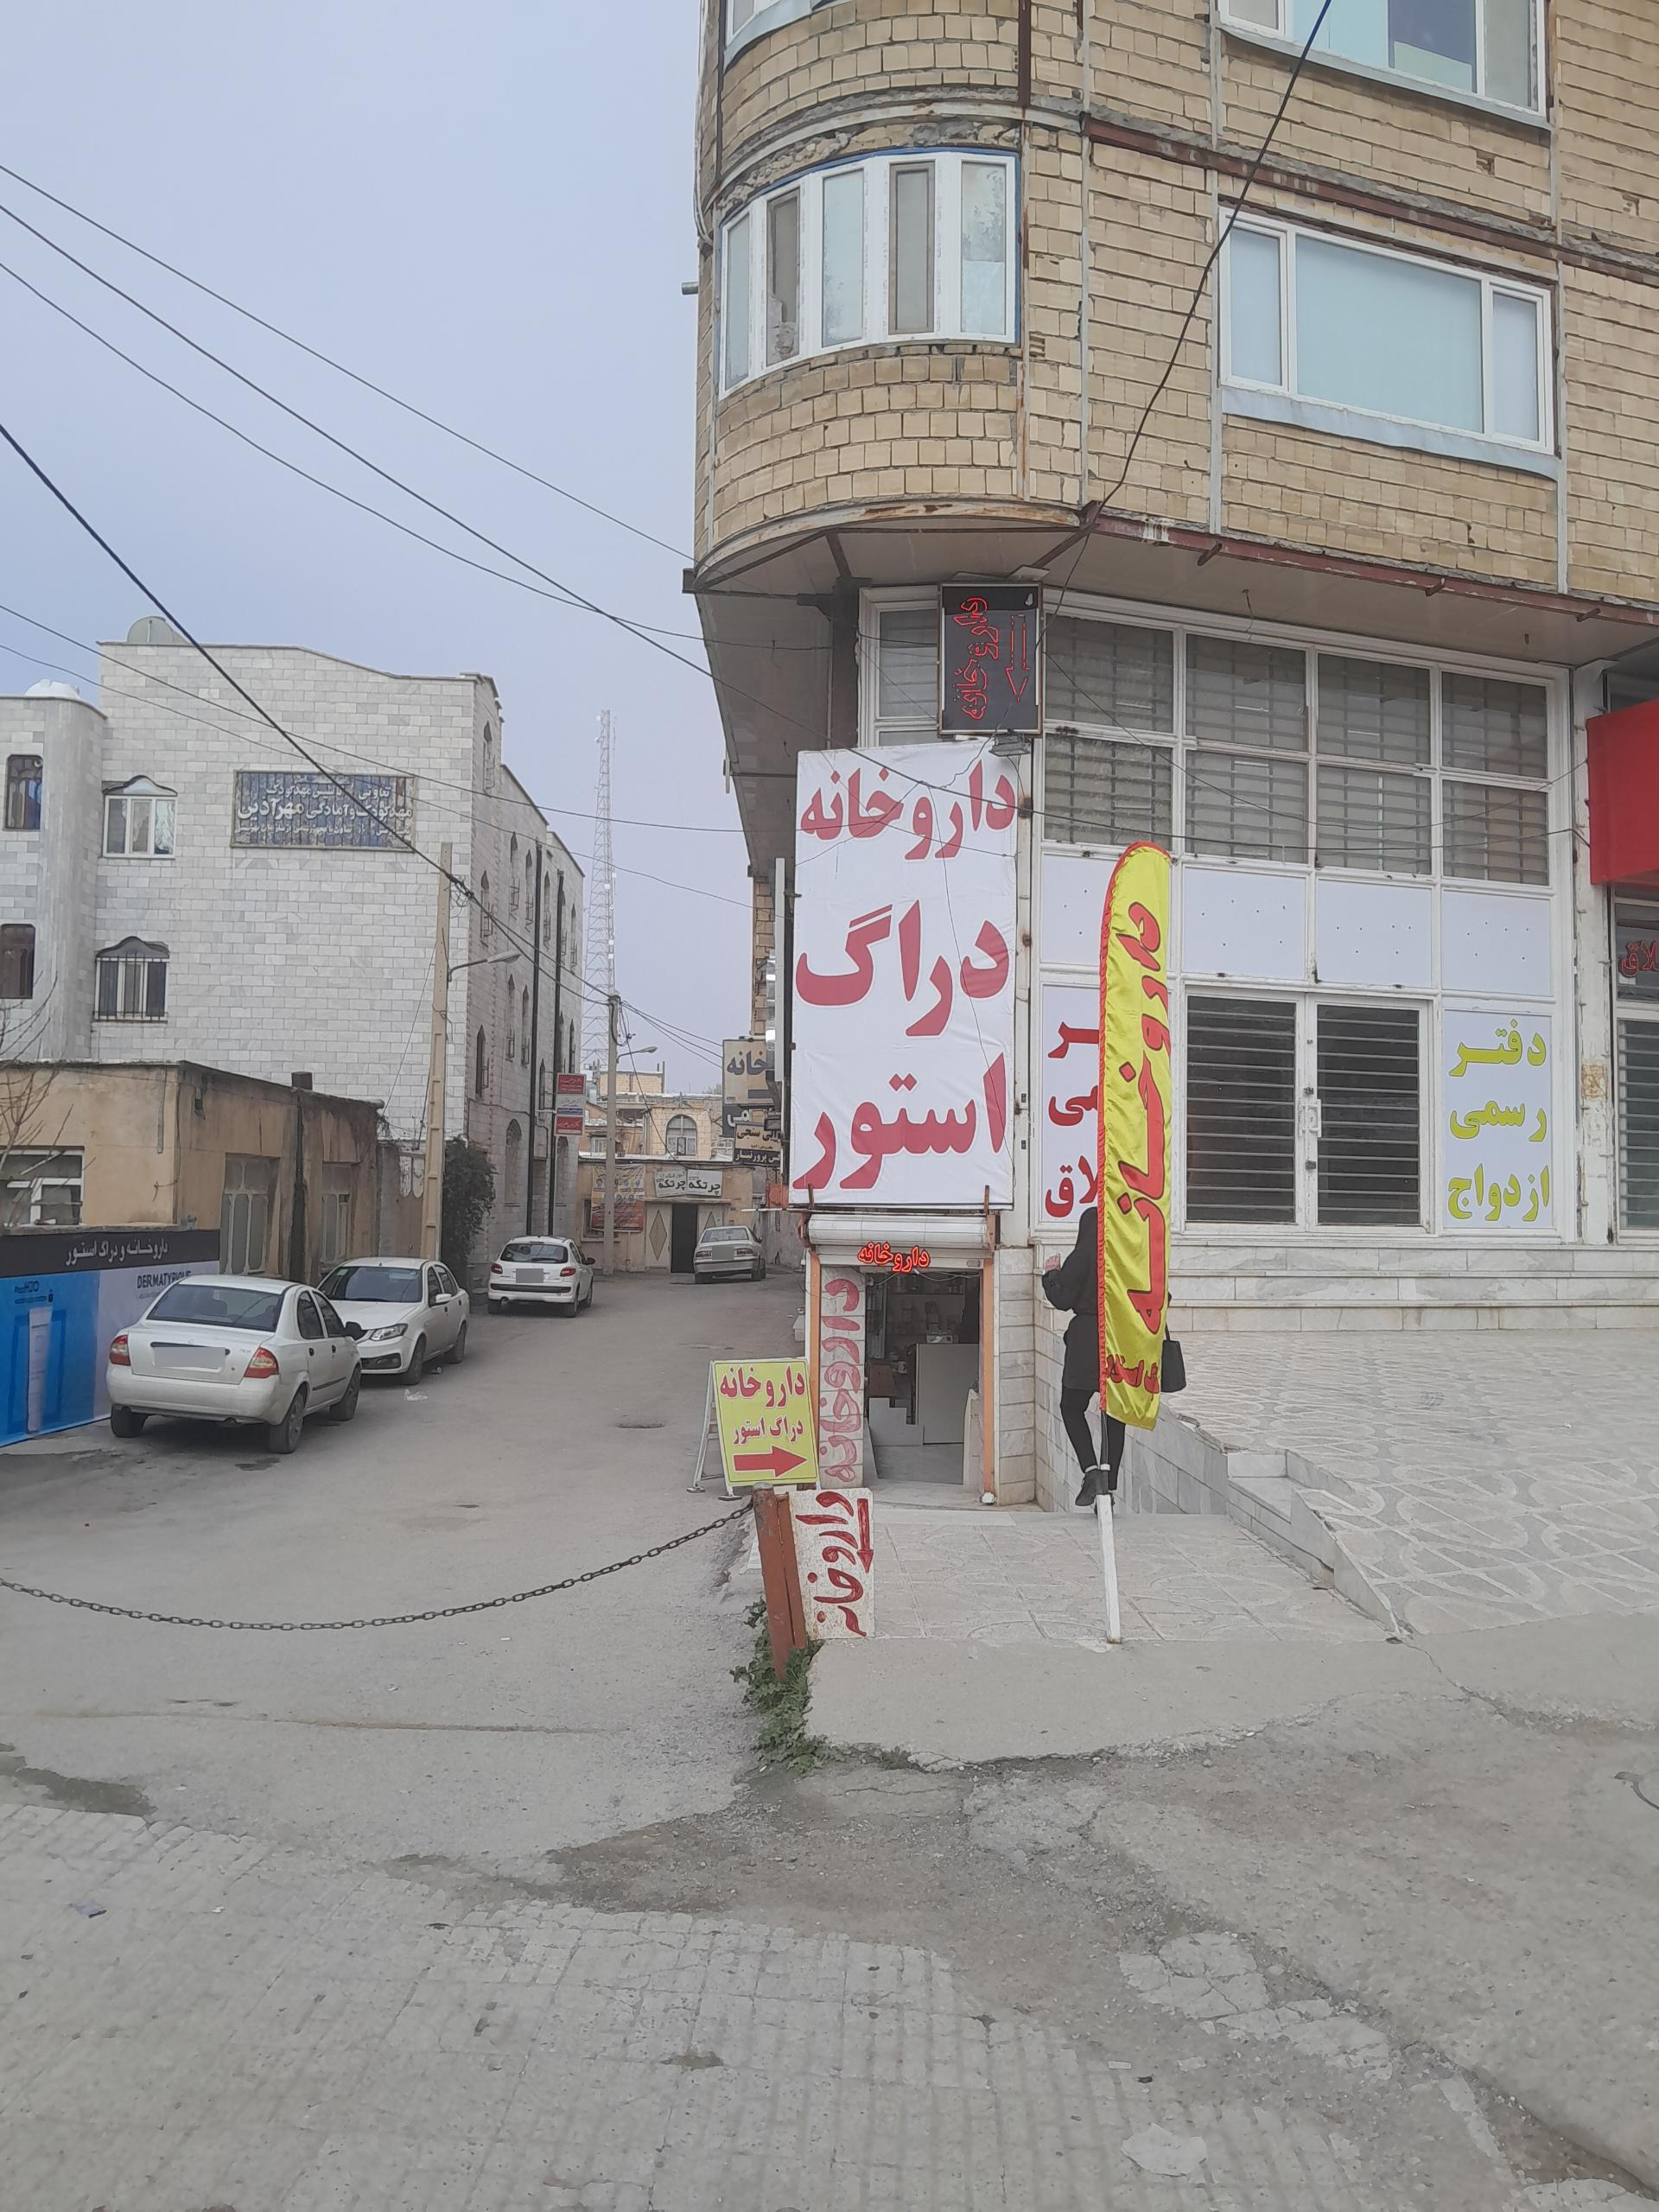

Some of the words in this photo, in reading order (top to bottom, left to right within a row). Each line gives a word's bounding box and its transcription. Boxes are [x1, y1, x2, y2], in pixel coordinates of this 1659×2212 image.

[953, 596, 999, 720] داروخانه
[800, 759, 1015, 861] داروخانه
[795, 900, 1010, 1037] دراگ
[1618, 938, 1659, 977] لاق
[1449, 1018, 1546, 1077] دفتر
[792, 1052, 1007, 1190] استور
[1116, 901, 1172, 1336] داروخانه
[1449, 1096, 1546, 1142] رسمی
[1447, 1162, 1550, 1223] ازدواج
[66, 1240, 98, 1266] استور
[127, 1236, 168, 1260] داروخانه
[858, 1242, 931, 1273] داروخانه
[720, 1365, 805, 1408] داروخانه
[821, 1278, 861, 1483] داروخانه
[733, 1416, 766, 1444] استور
[769, 1415, 804, 1443] دراگ
